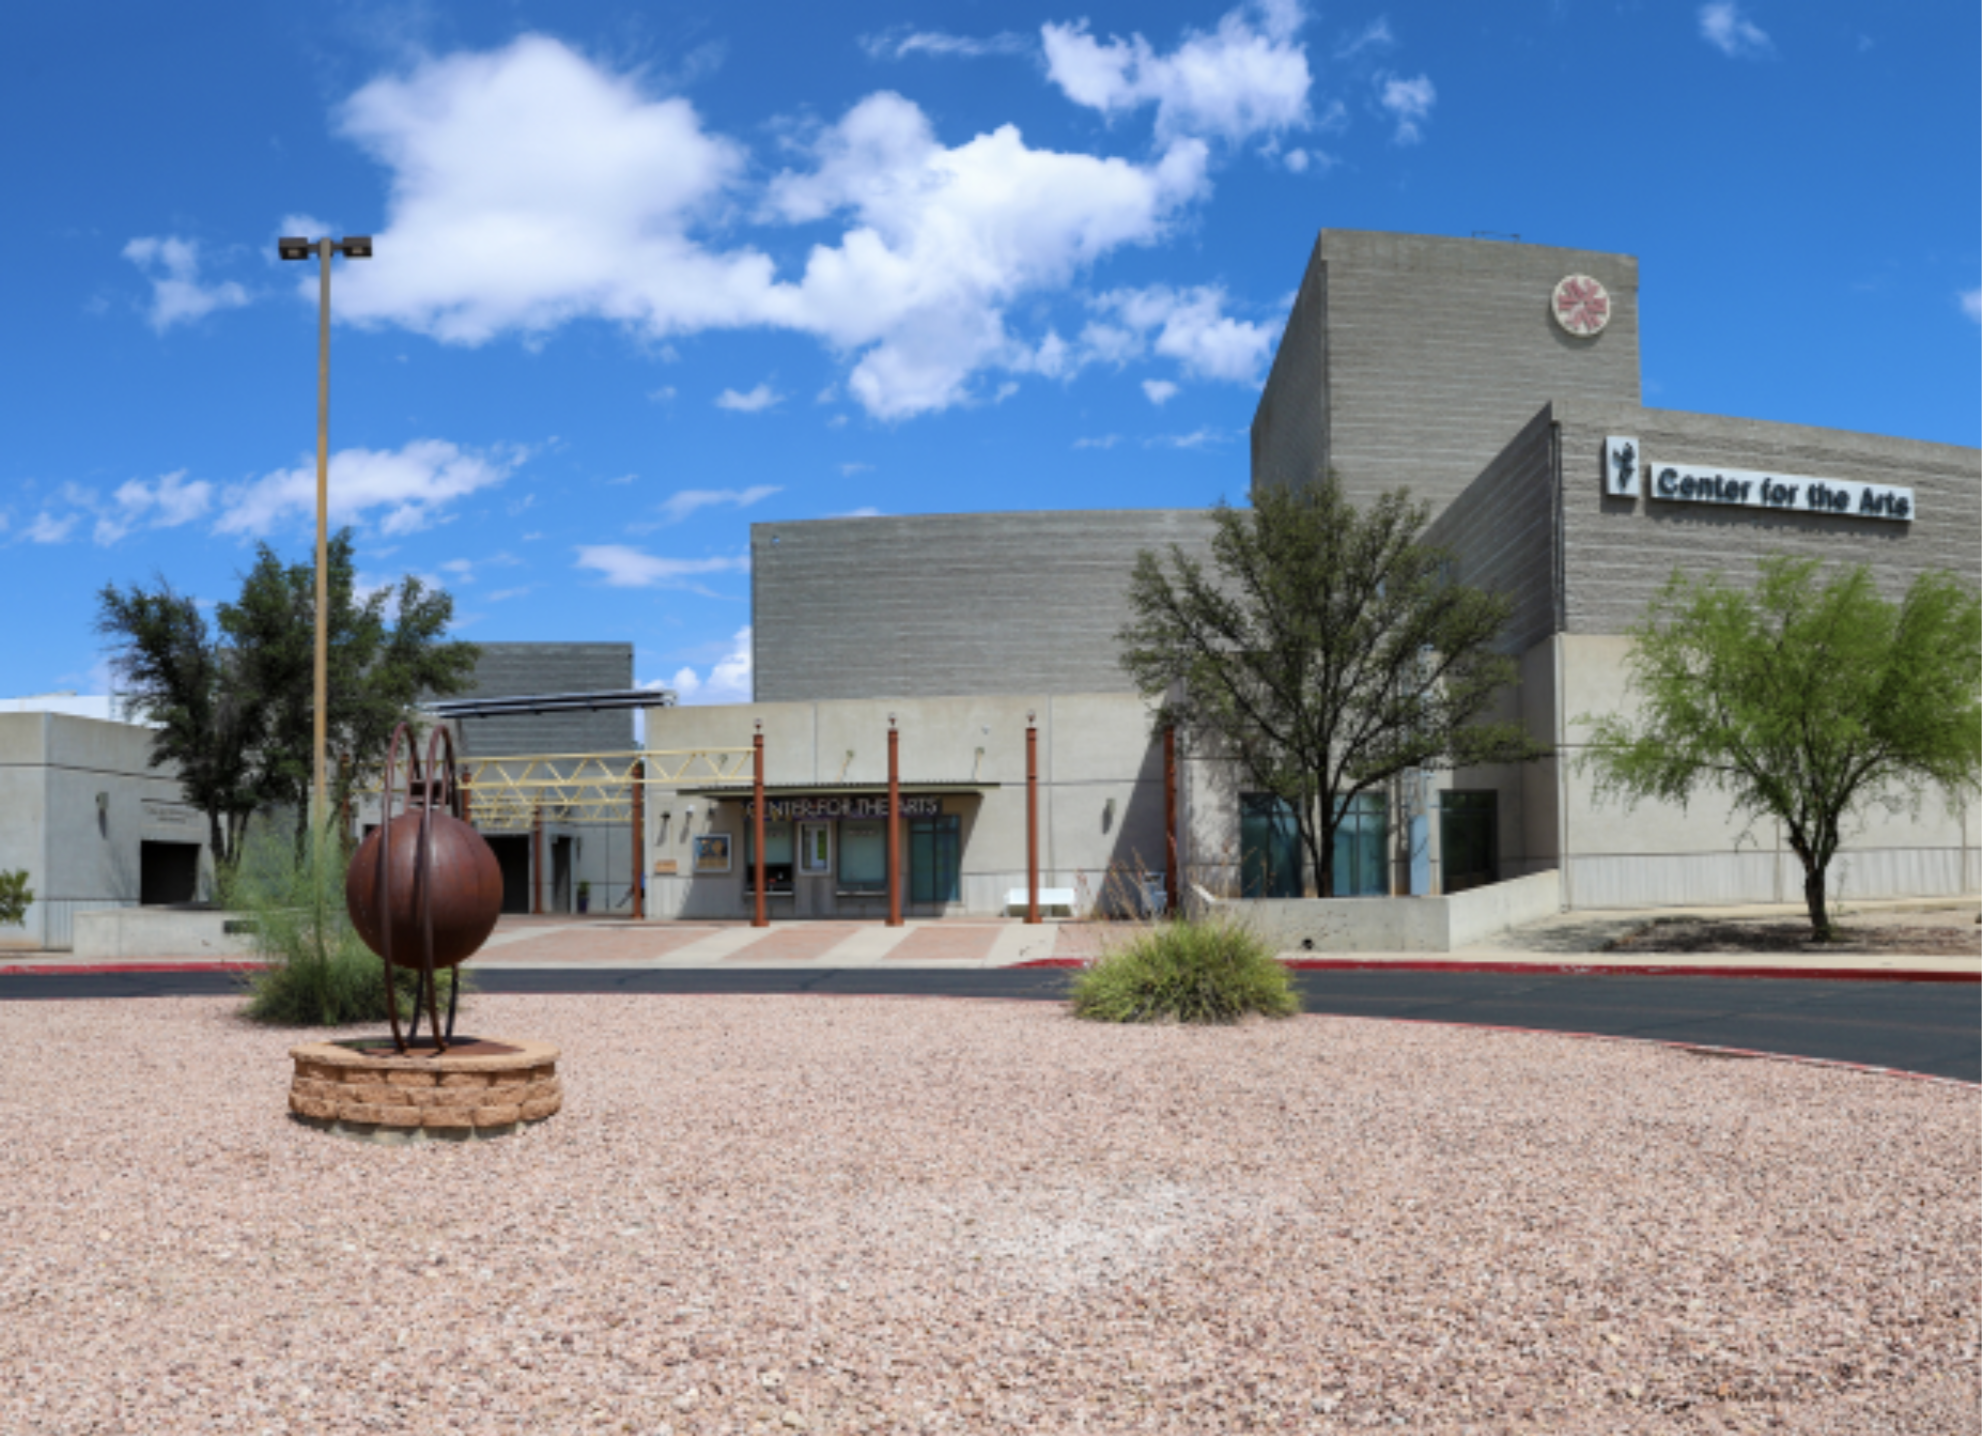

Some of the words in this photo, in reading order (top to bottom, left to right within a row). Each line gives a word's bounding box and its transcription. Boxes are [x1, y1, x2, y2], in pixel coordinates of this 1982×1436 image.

[1657, 467, 1752, 500] Center
[1761, 477, 1799, 506] for
[1806, 482, 1851, 512] the
[1860, 487, 1910, 517] Arts
[746, 799, 814, 816] CNTER
[817, 798, 853, 815] FOR
[856, 798, 889, 815] THE
[896, 797, 938, 814] ARTS
